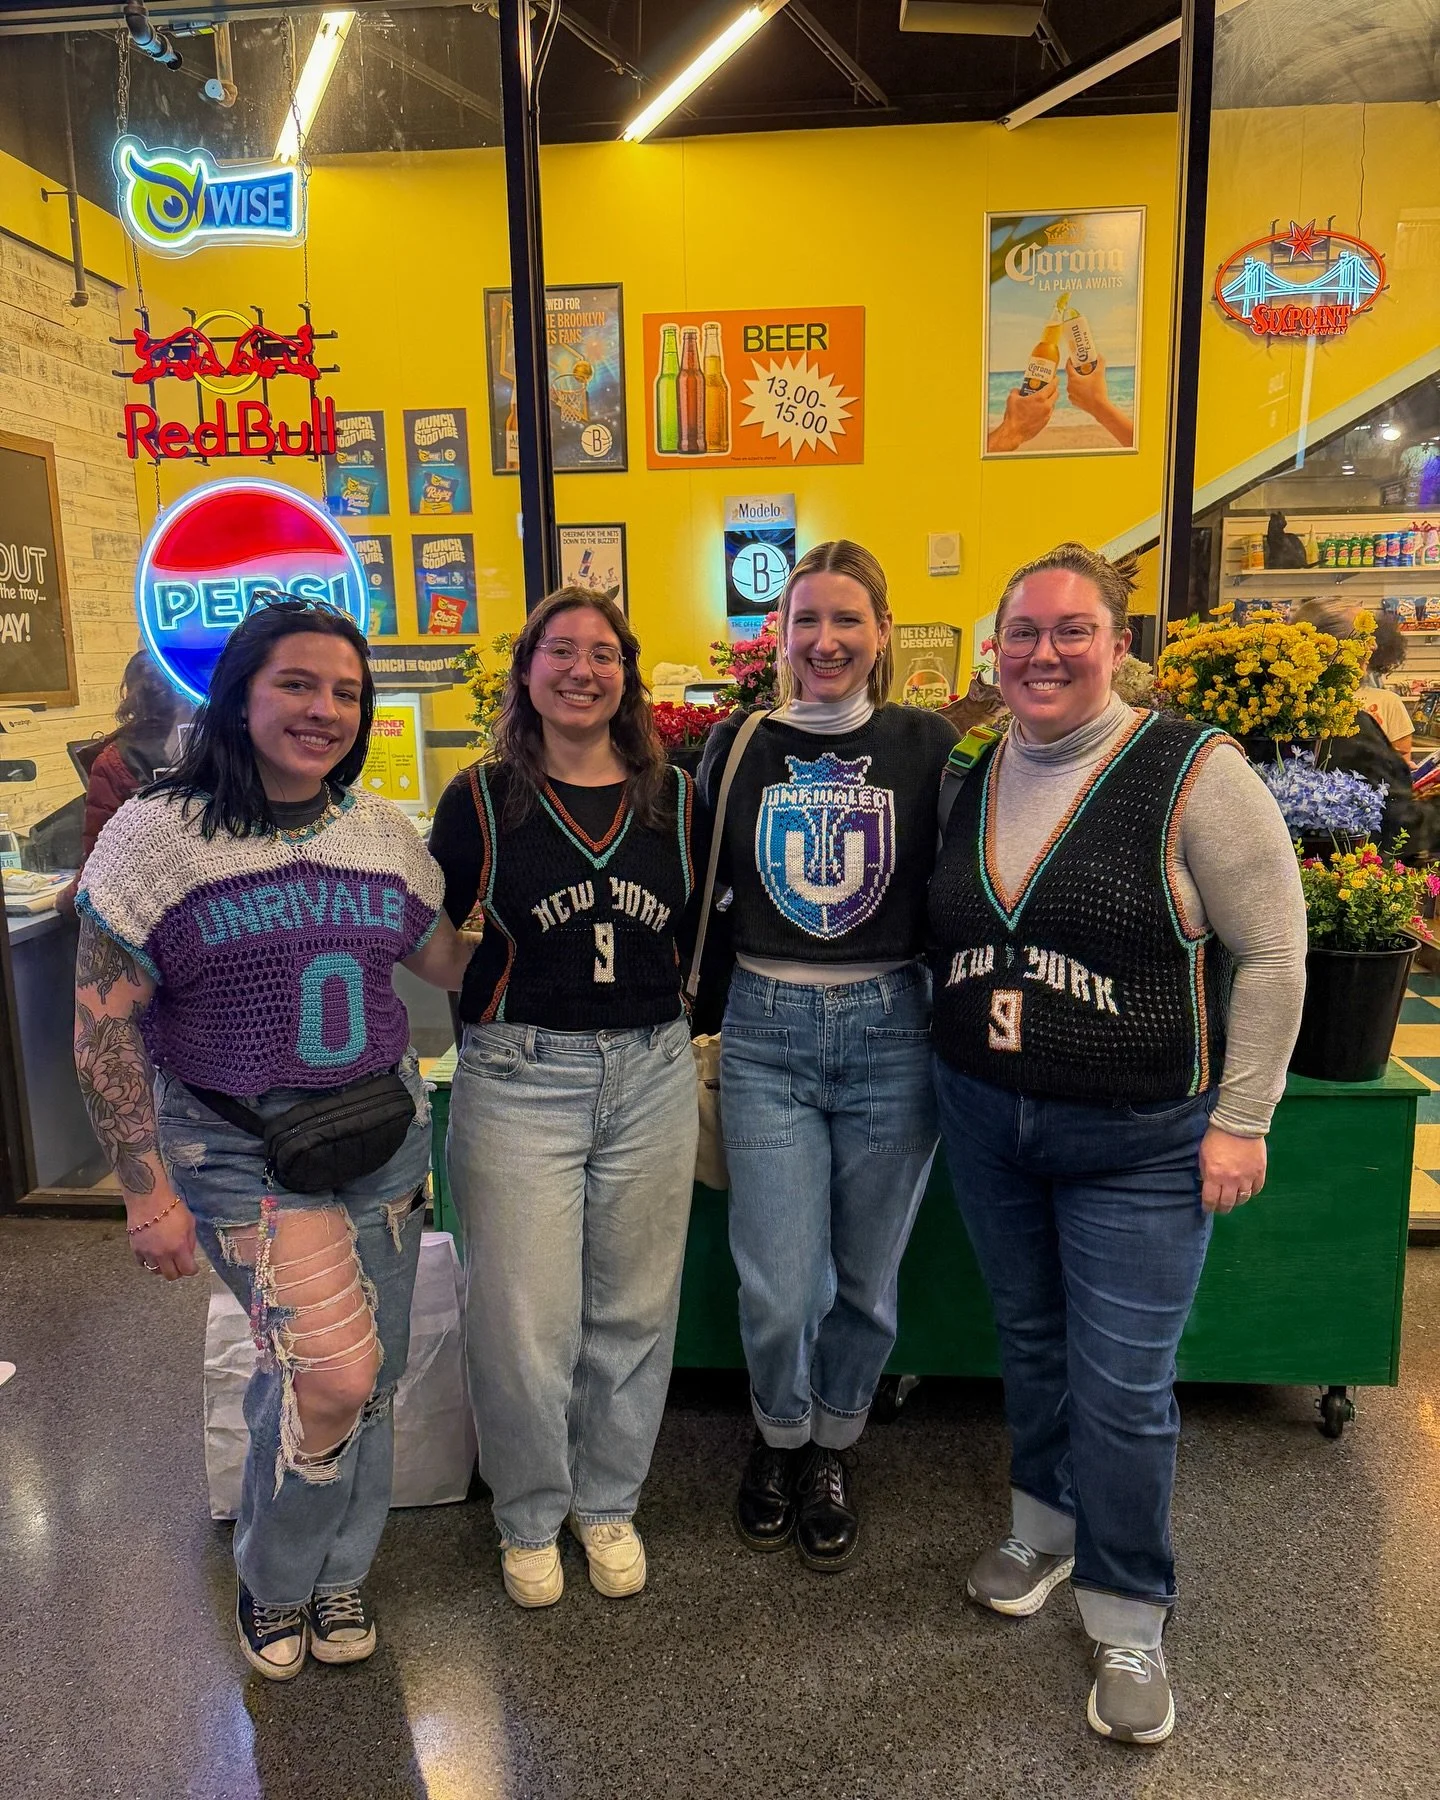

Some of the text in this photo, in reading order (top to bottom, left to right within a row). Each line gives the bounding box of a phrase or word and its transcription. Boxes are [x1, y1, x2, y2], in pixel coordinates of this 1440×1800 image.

[209, 183, 286, 227] WISE
[1005, 242, 1125, 286] Corona
[1039, 277, 1123, 291] LA PLAYA AWAITS
[565, 298, 581, 310] FOR
[557, 312, 605, 329] BROOKLYN
[743, 323, 828, 352] BEER
[124, 396, 337, 459] Red Bull
[415, 414, 456, 431] MUNCH
[775, 402, 828, 434] 15.00
[414, 427, 459, 446] GOOD VIBE
[739, 503, 780, 518] Modelo
[356, 540, 382, 553] NCH
[423, 539, 463, 555] MUNCH
[423, 551, 466, 569] GOOD VIBE
[753, 552, 770, 594] B
[0, 612, 31, 643] AY!
[900, 626, 954, 639] NETS FANS
[900, 637, 954, 649] DESERVE
[372, 720, 405, 728] ORNER
[785, 830, 865, 904] U
[192, 879, 406, 946] UNRIVALE
[531, 876, 671, 933] NEW YORK
[593, 922, 616, 983] 9
[1022, 945, 1120, 1016] YORK
[296, 951, 367, 1068] 0
[988, 988, 1024, 1052] 9
